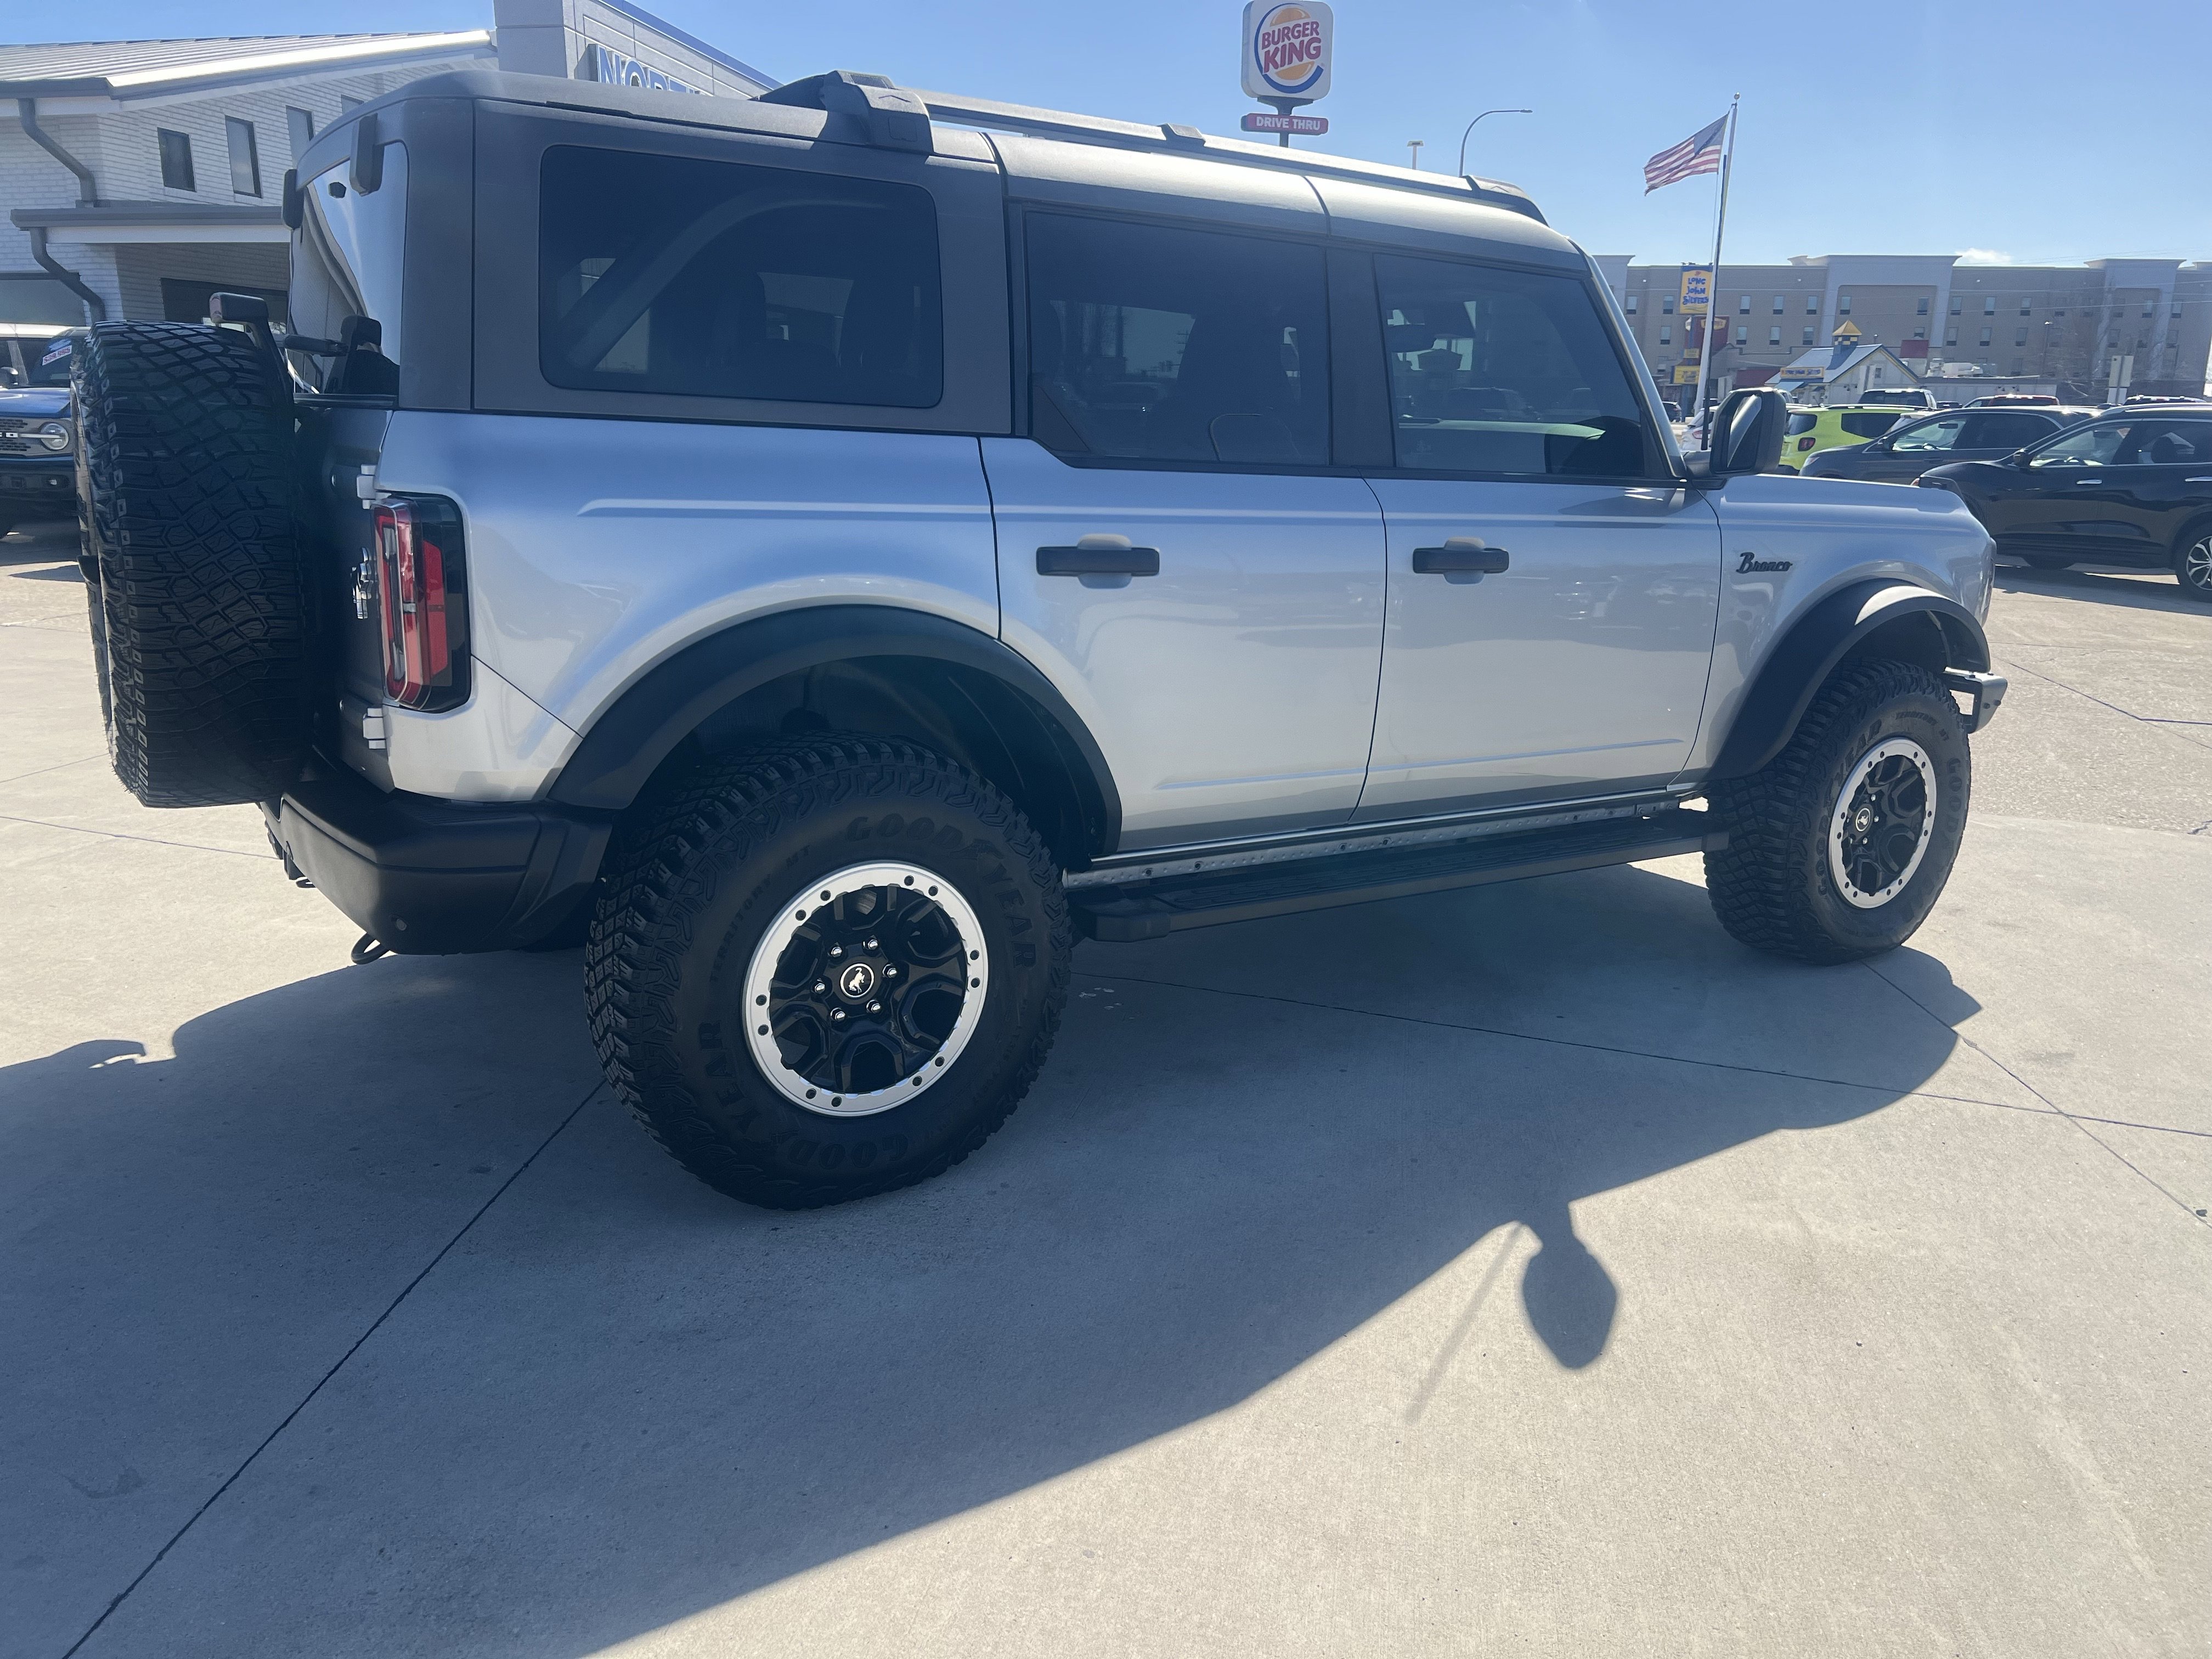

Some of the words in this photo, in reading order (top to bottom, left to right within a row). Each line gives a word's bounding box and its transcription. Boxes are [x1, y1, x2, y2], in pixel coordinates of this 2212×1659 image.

[1262, 21, 1319, 50] BURGER
[1264, 37, 1322, 73] KING
[1256, 116, 1289, 128] DRIVE
[1293, 119, 1320, 131] THRU
[1736, 552, 1793, 574] Bronco
